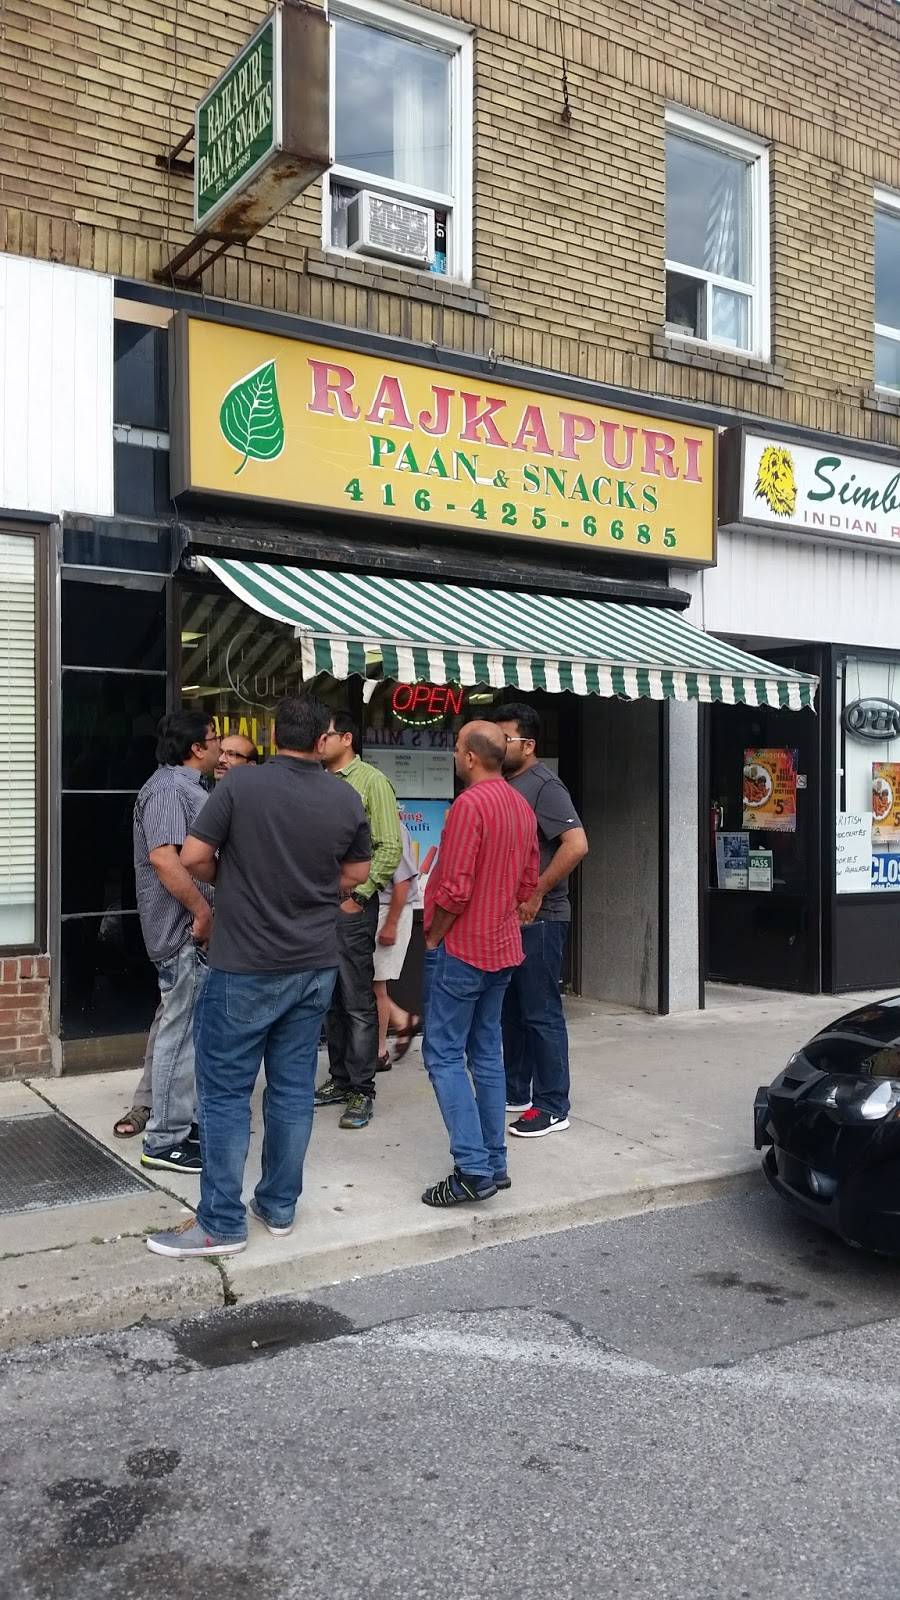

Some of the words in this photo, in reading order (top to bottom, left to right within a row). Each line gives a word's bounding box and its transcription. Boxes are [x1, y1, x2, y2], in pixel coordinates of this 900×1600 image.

[207, 44, 263, 146] RAJKAPURI
[199, 134, 224, 195] PAAN
[224, 130, 233, 170] &
[235, 80, 272, 160] SNACKS
[436, 222, 445, 238] LG
[306, 357, 703, 483] RAJKAPURI
[368, 434, 480, 484] PAAN
[492, 469, 510, 489] &
[522, 463, 659, 513] SNACKS
[804, 510, 877, 534] INDIAN
[392, 683, 464, 715] OPEN
[836, 815, 862, 826] RITISH
[836, 844, 845, 852] ND
[750, 859, 769, 867] PASS
